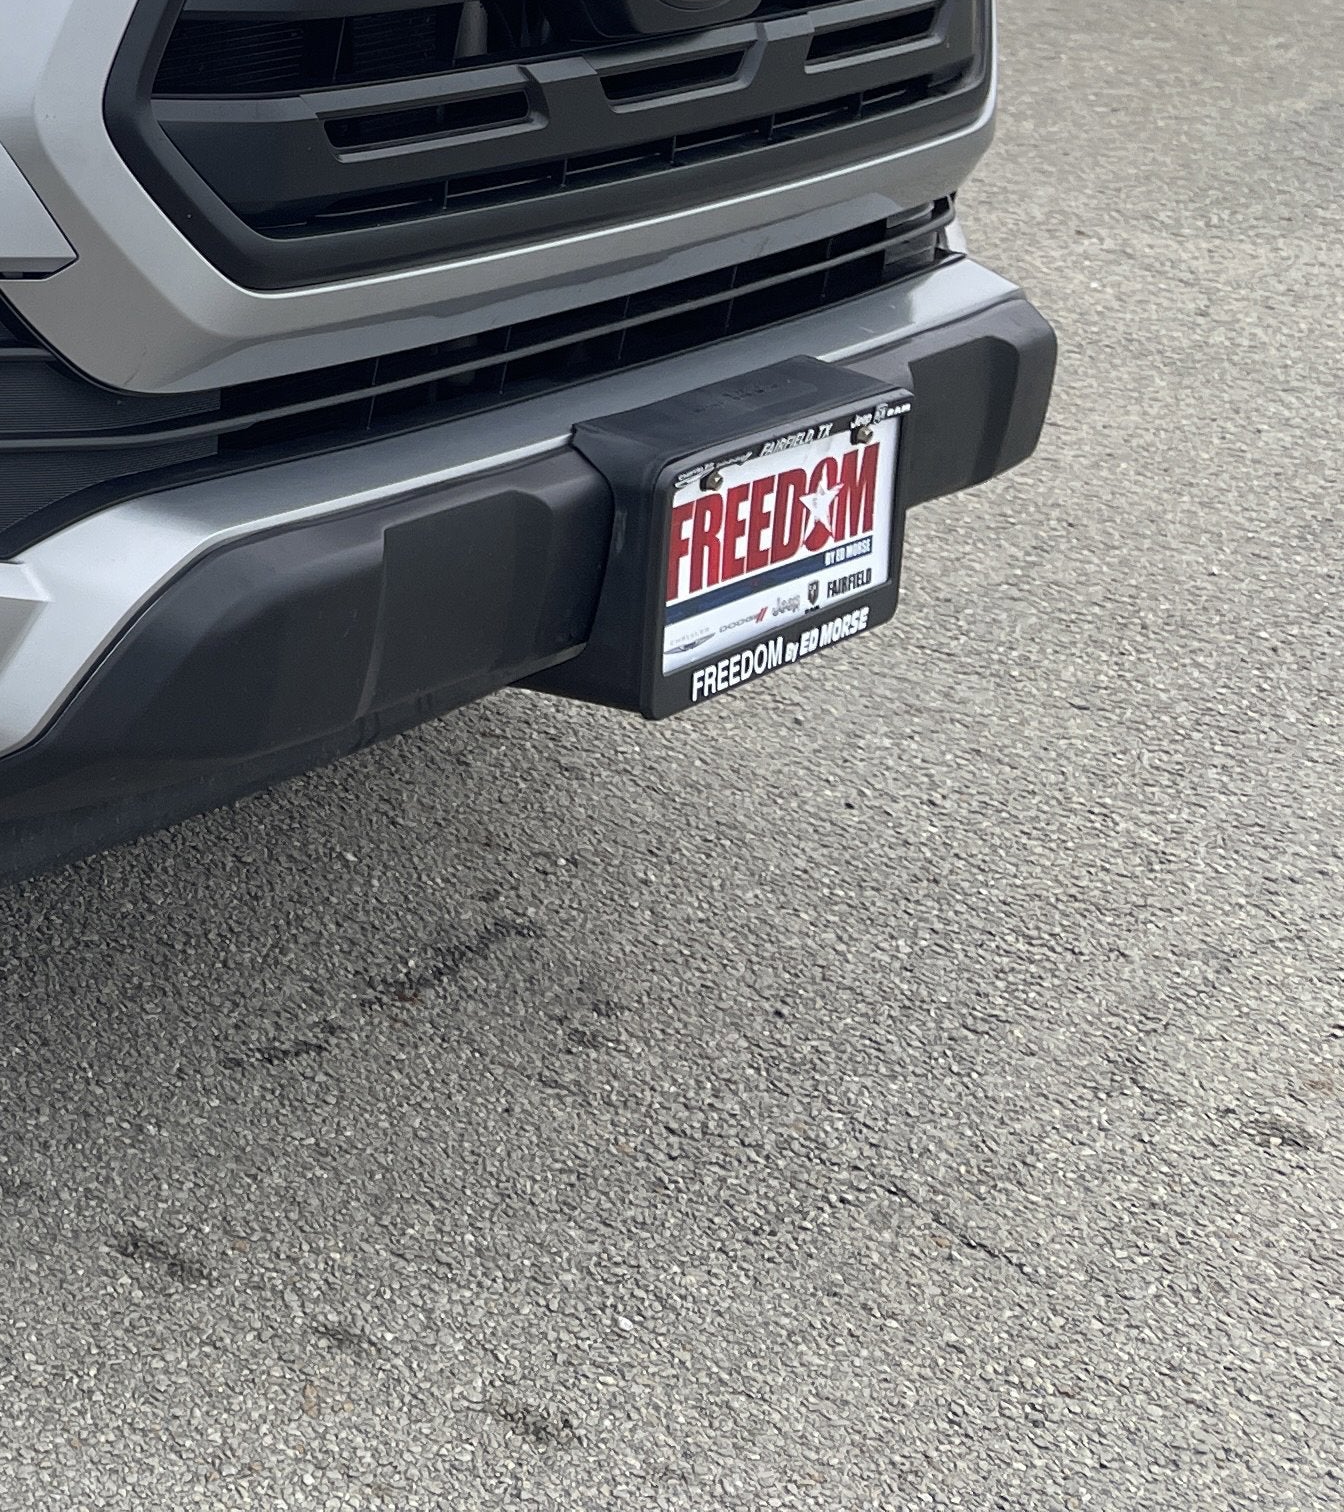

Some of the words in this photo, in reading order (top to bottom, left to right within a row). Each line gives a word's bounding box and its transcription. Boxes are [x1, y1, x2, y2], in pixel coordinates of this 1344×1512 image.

[816, 422, 834, 438] TX
[665, 441, 881, 602] FREEDOM
[824, 551, 836, 567] BY
[835, 548, 845, 564] ED
[845, 537, 872, 561] MORSE
[826, 567, 872, 599] FAIRFIELD
[771, 594, 801, 617] Jeep
[691, 636, 783, 703] FREEDOM
[799, 629, 819, 656] ED
[819, 605, 870, 648] MORSE
